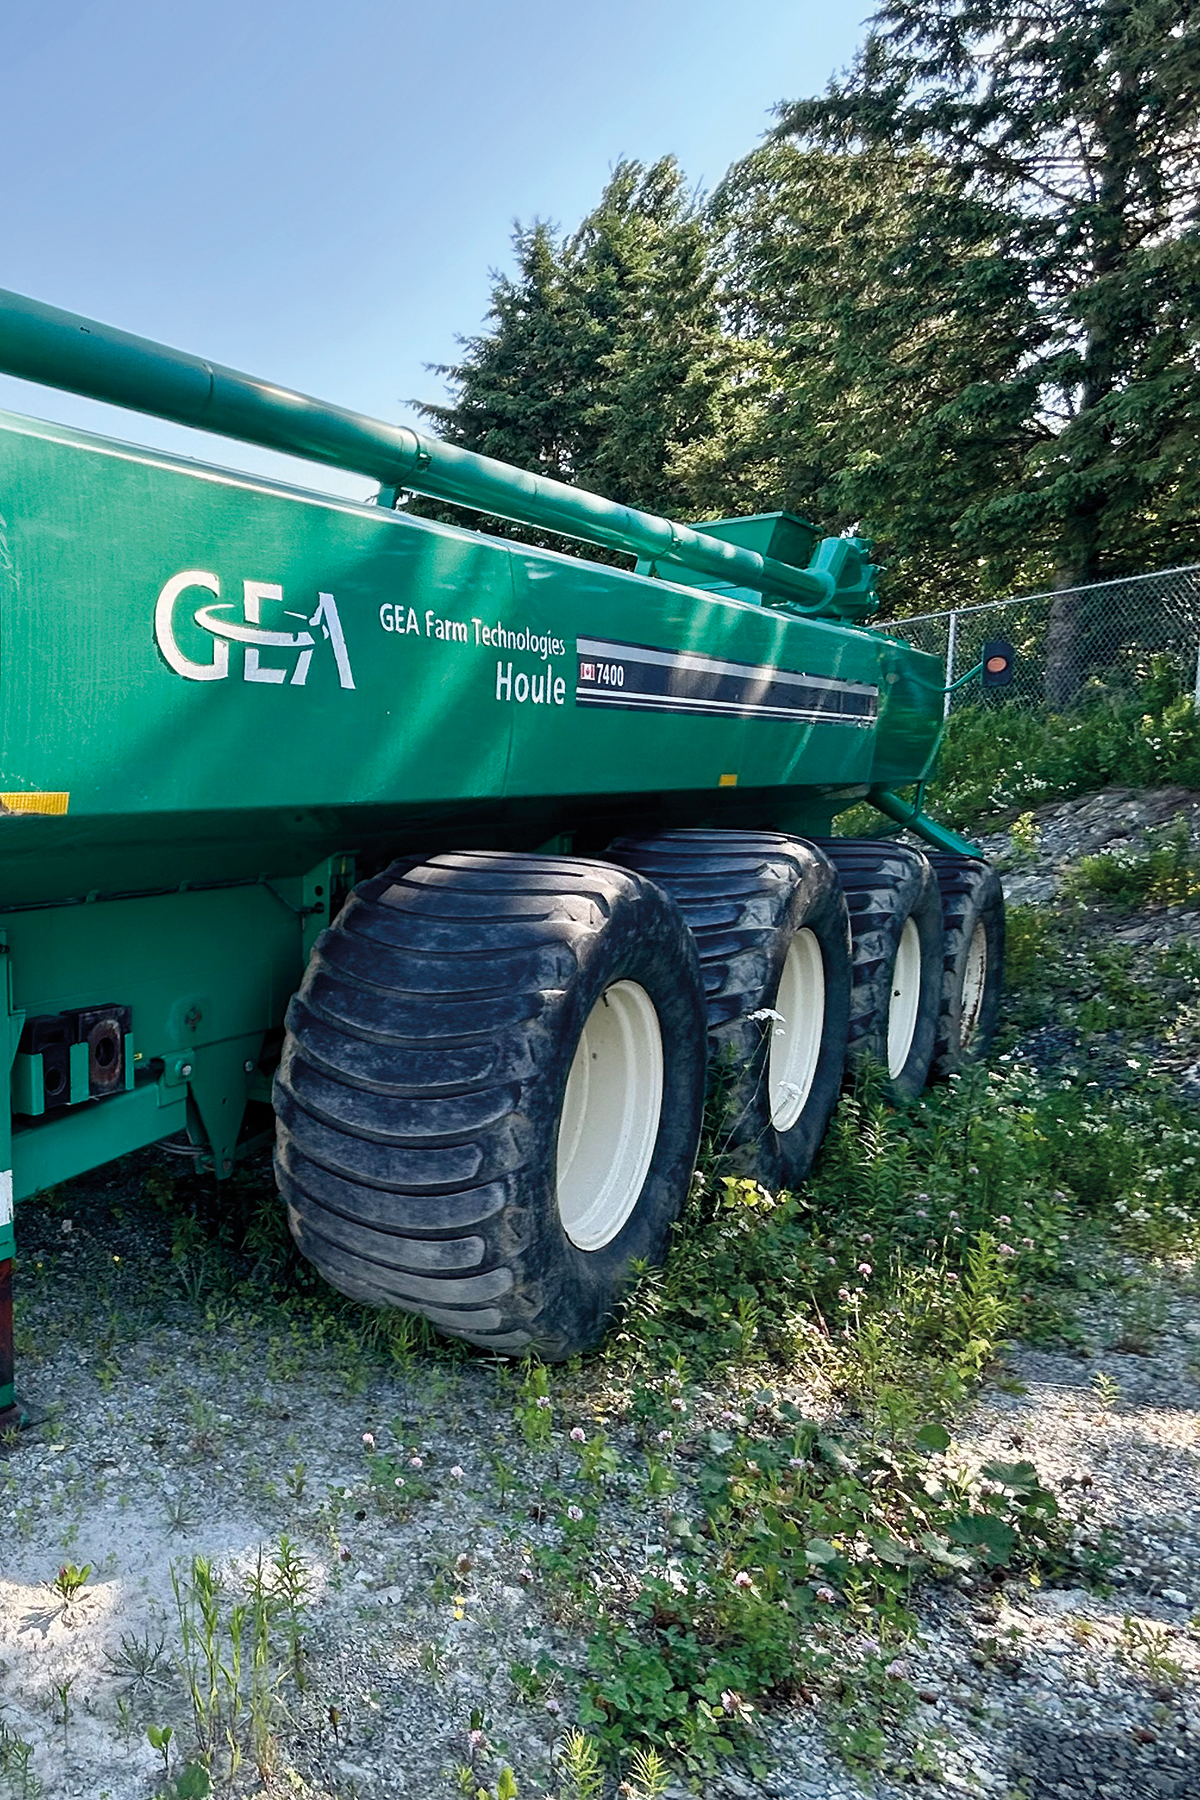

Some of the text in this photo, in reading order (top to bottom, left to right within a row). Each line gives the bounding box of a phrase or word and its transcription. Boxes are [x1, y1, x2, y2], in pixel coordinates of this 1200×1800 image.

[155, 569, 356, 689] GEA
[379, 603, 566, 660] GEA Farm Technologies
[496, 661, 566, 705] Houle
[596, 663, 625, 687] 7400
